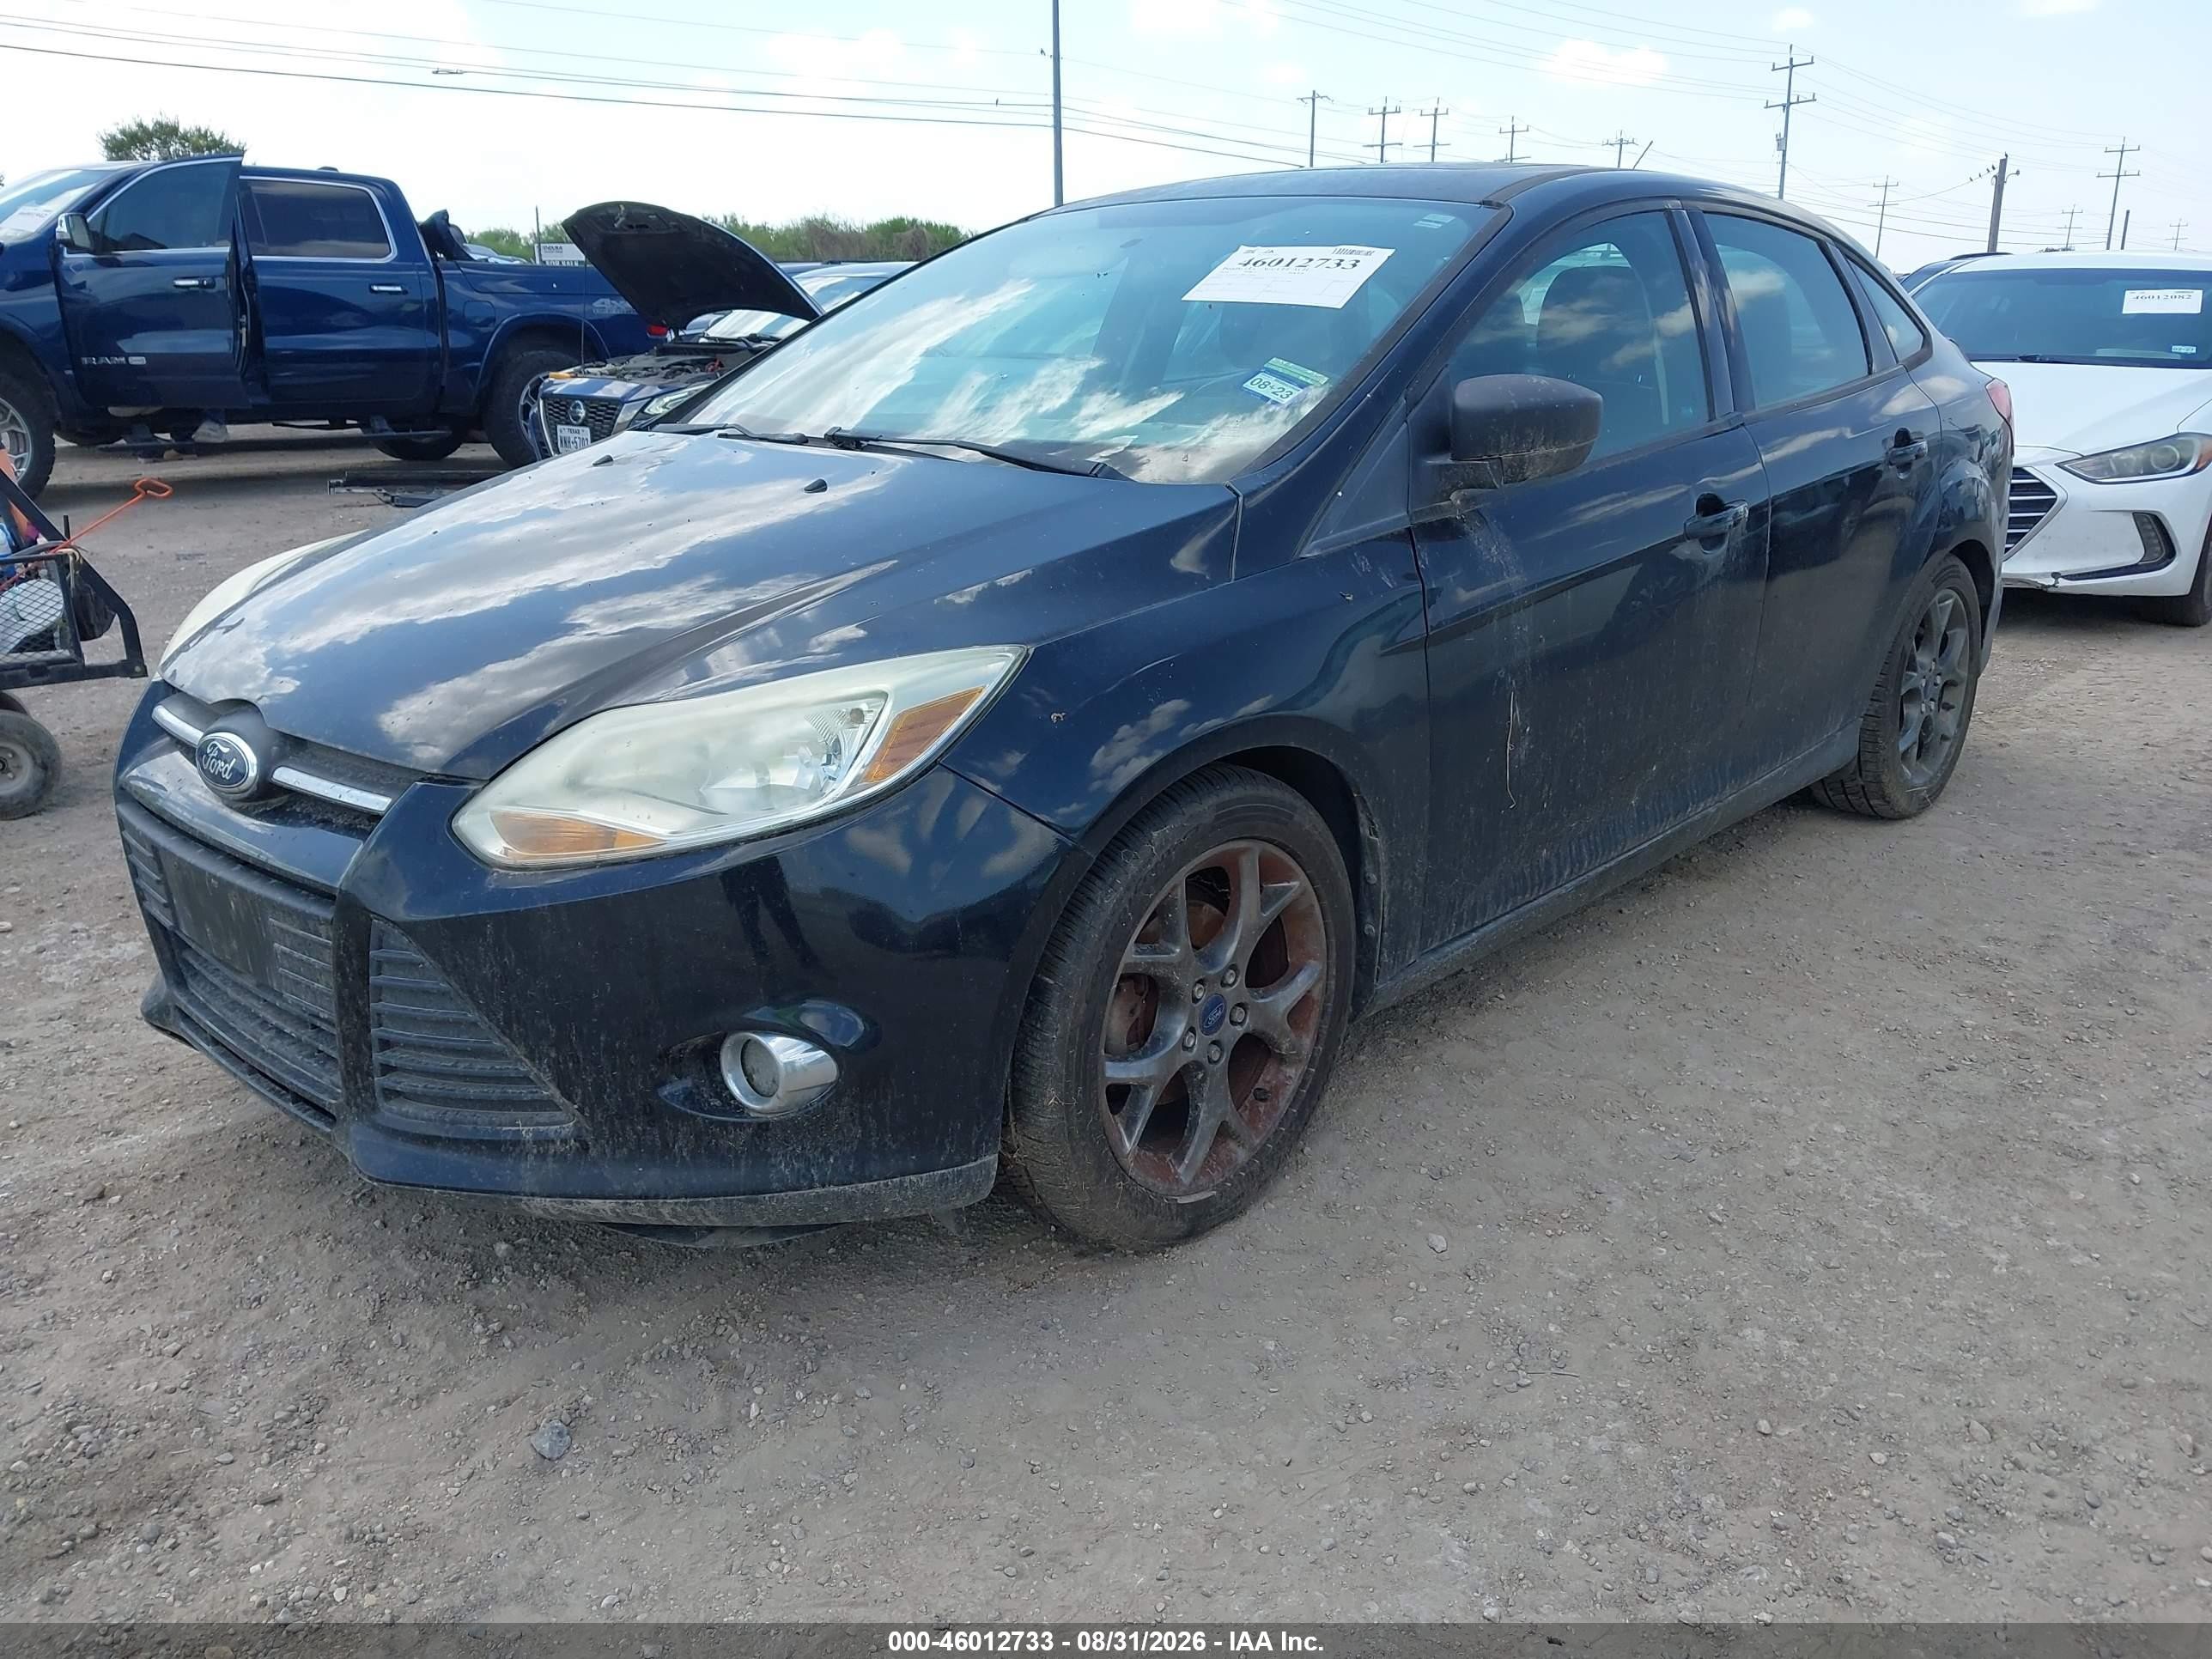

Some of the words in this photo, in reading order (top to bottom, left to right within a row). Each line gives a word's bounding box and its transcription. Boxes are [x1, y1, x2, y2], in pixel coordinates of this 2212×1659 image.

[1237, 257, 1360, 270] 46012733
[81, 356, 126, 365] RAM
[203, 741, 236, 780] Ford
